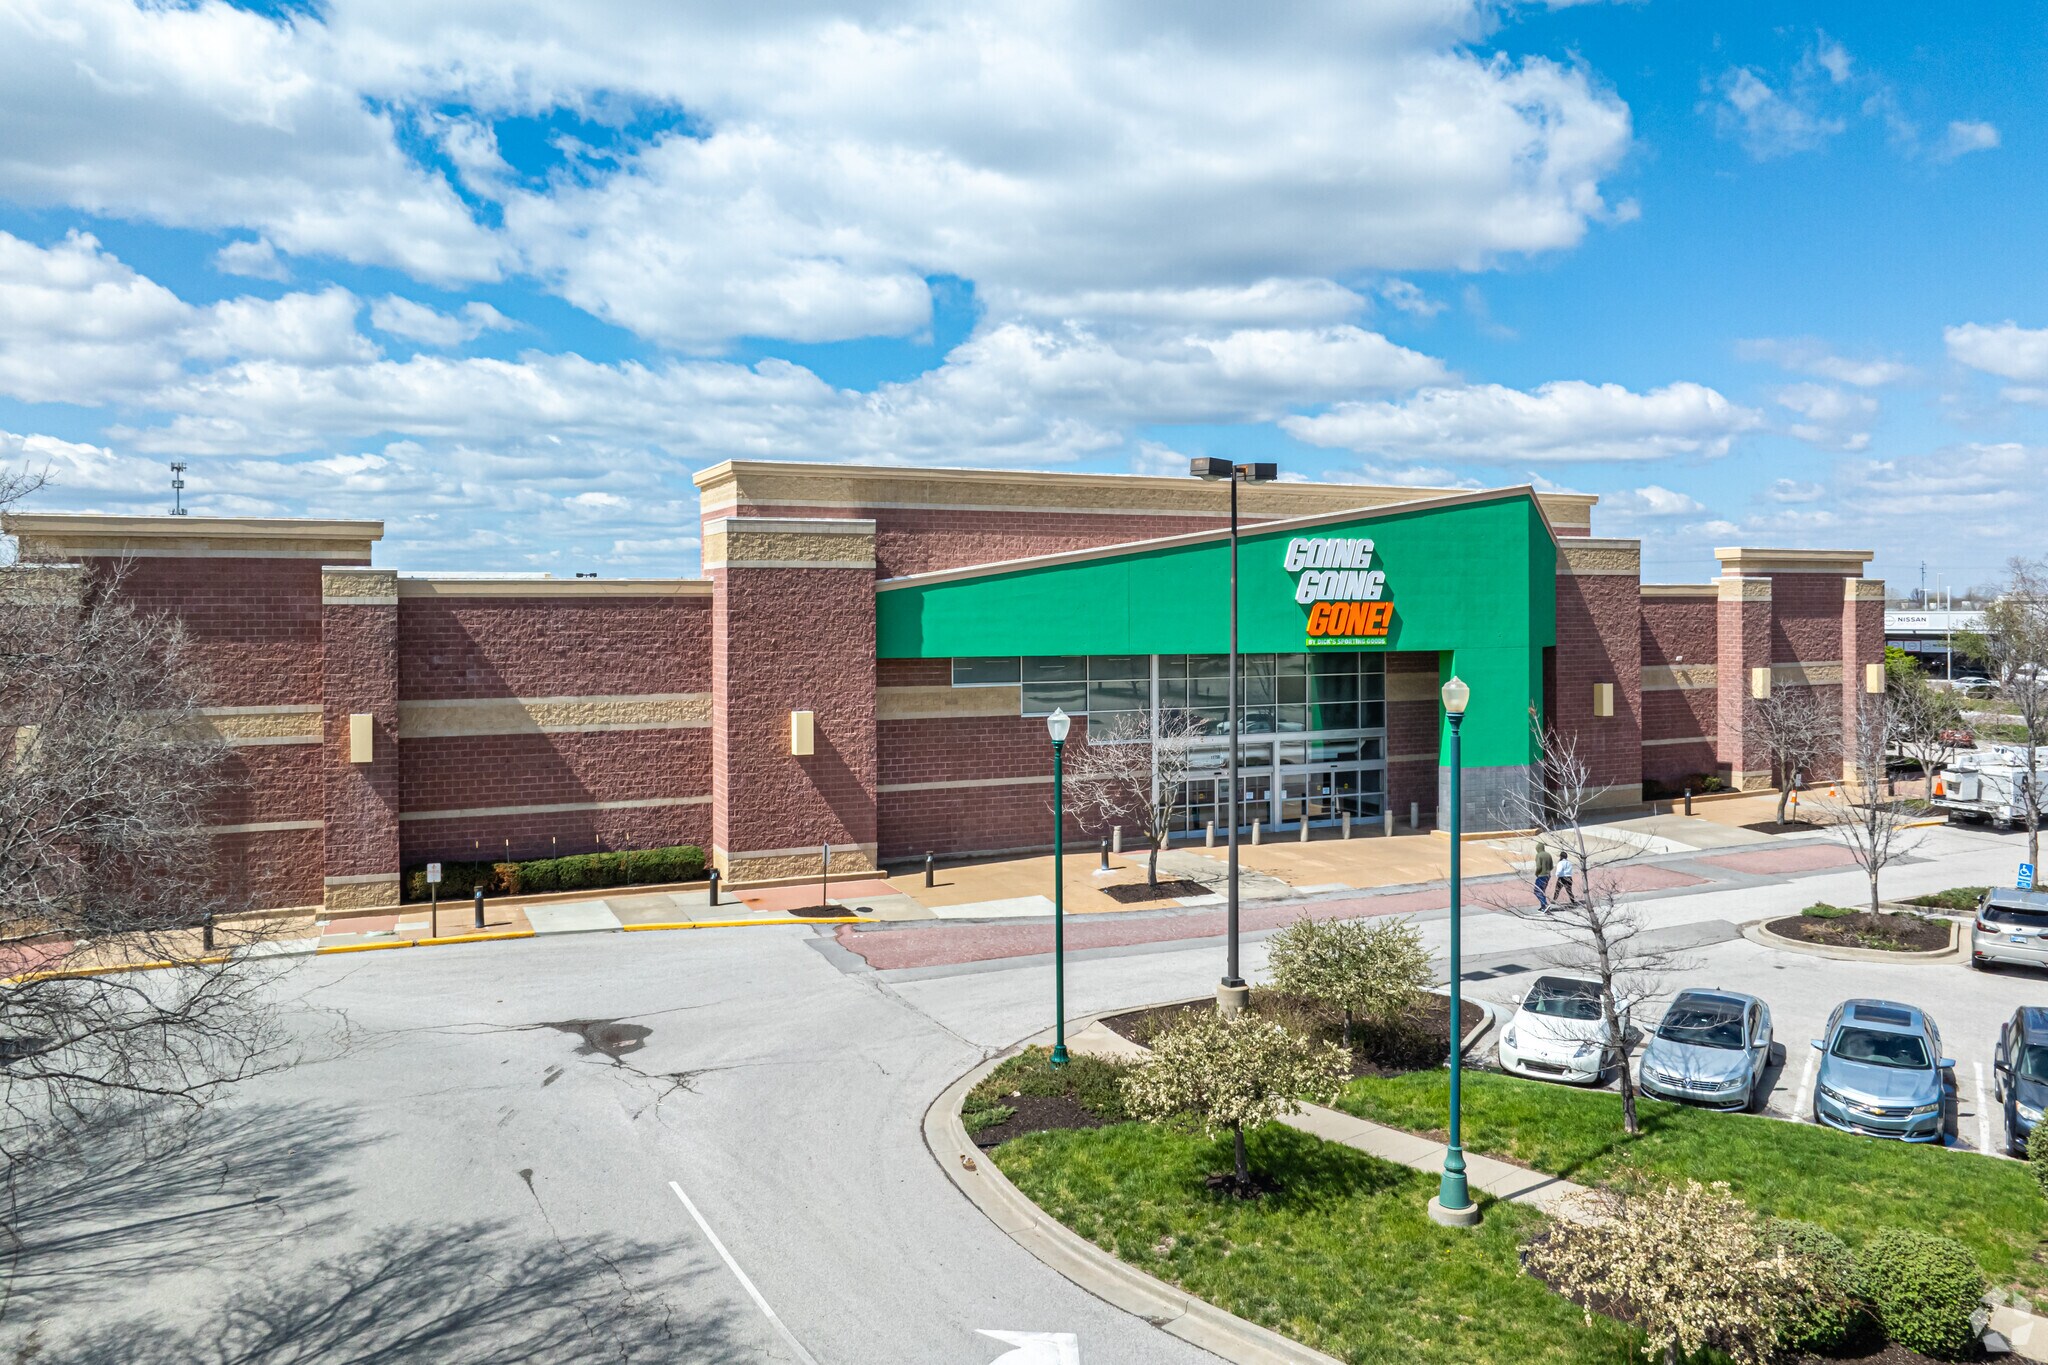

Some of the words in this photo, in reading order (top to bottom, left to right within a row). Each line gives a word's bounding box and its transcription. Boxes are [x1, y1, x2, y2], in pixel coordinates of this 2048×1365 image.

[1284, 538, 1374, 571] GOING
[1295, 570, 1386, 604] GOING
[1306, 602, 1394, 636] GONE!
